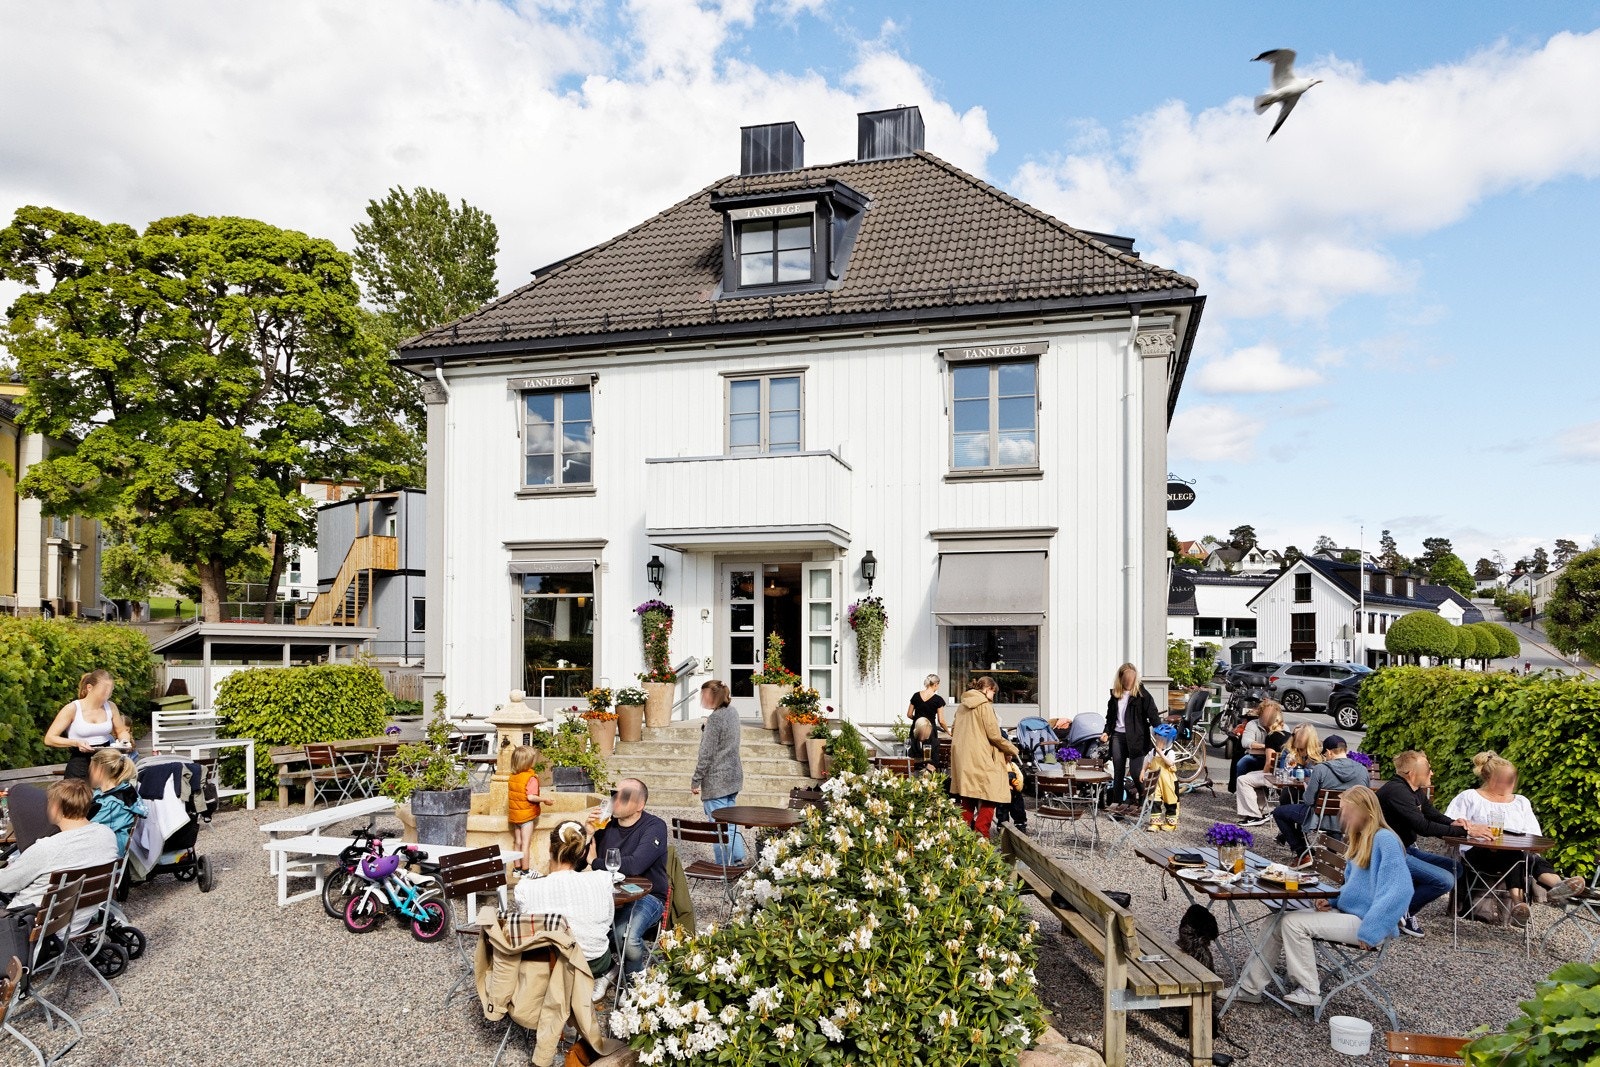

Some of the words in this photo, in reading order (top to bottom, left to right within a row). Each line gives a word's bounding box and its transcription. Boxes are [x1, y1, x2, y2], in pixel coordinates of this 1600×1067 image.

[746, 205, 801, 218] TANNLEGE
[963, 345, 1027, 359] TANNLEGE
[523, 376, 575, 388] TANNLEGE
